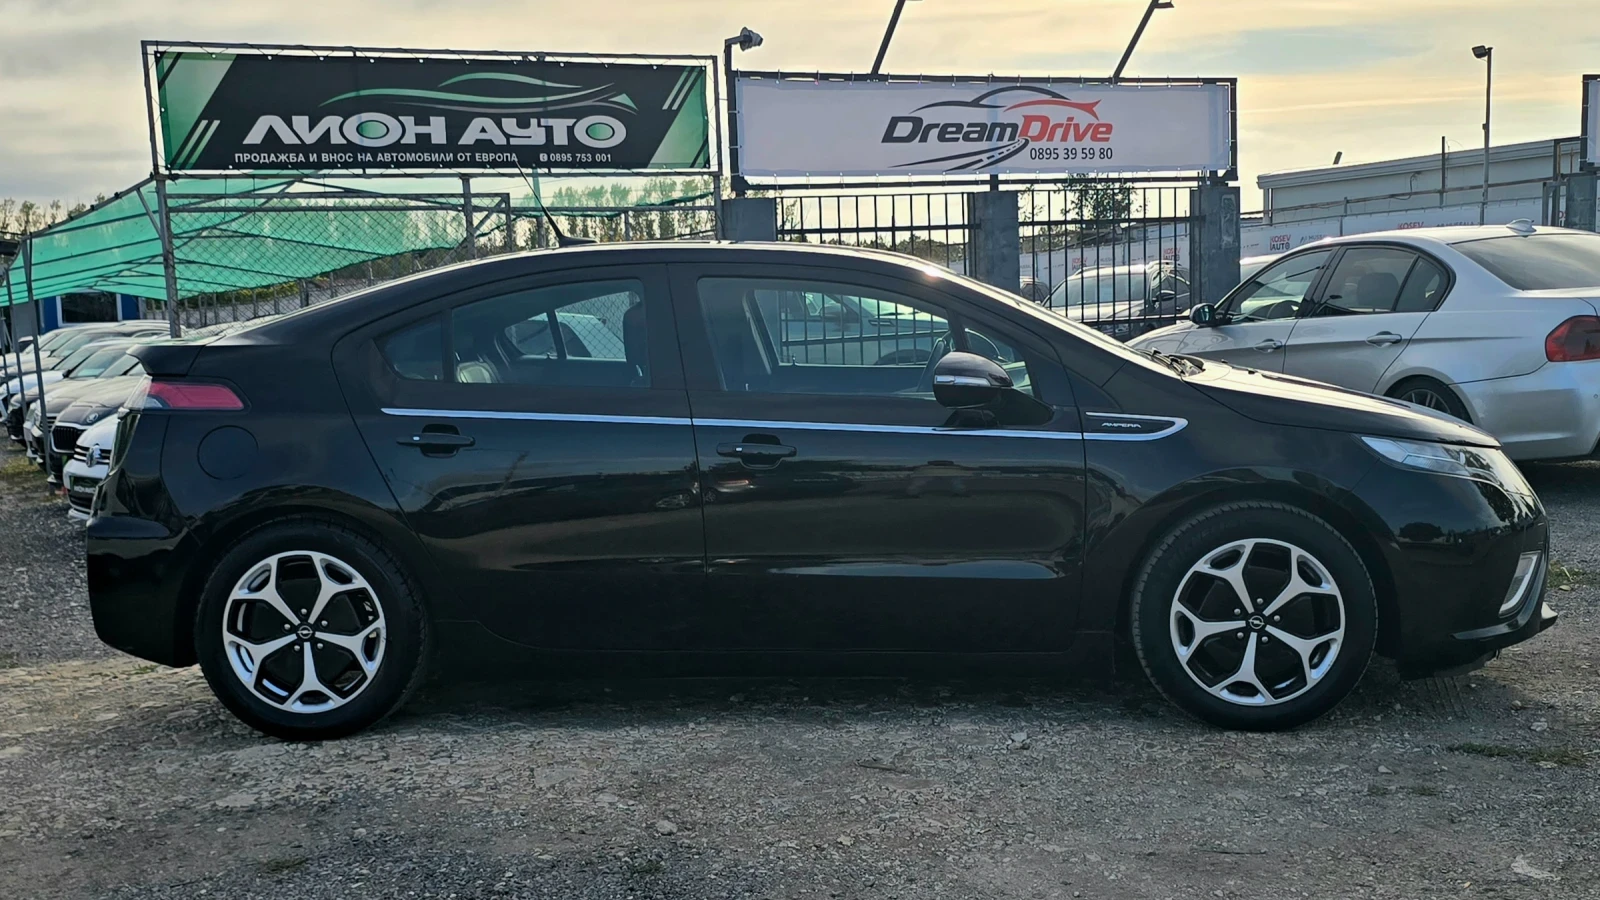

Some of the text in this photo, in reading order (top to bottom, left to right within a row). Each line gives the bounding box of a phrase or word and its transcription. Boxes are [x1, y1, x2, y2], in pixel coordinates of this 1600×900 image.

[242, 112, 627, 149] ЛИОН АУТО
[234, 153, 518, 164] ПРОДАЖБА И ВНОС НА АВТОМОБИЛИ ОТ ЕВРОПА
[549, 153, 612, 163] 0895 753 001
[1029, 147, 1113, 160] 0895 39 59 80
[1270, 234, 1291, 243] KOSEV
[1271, 243, 1291, 251] AUTO
